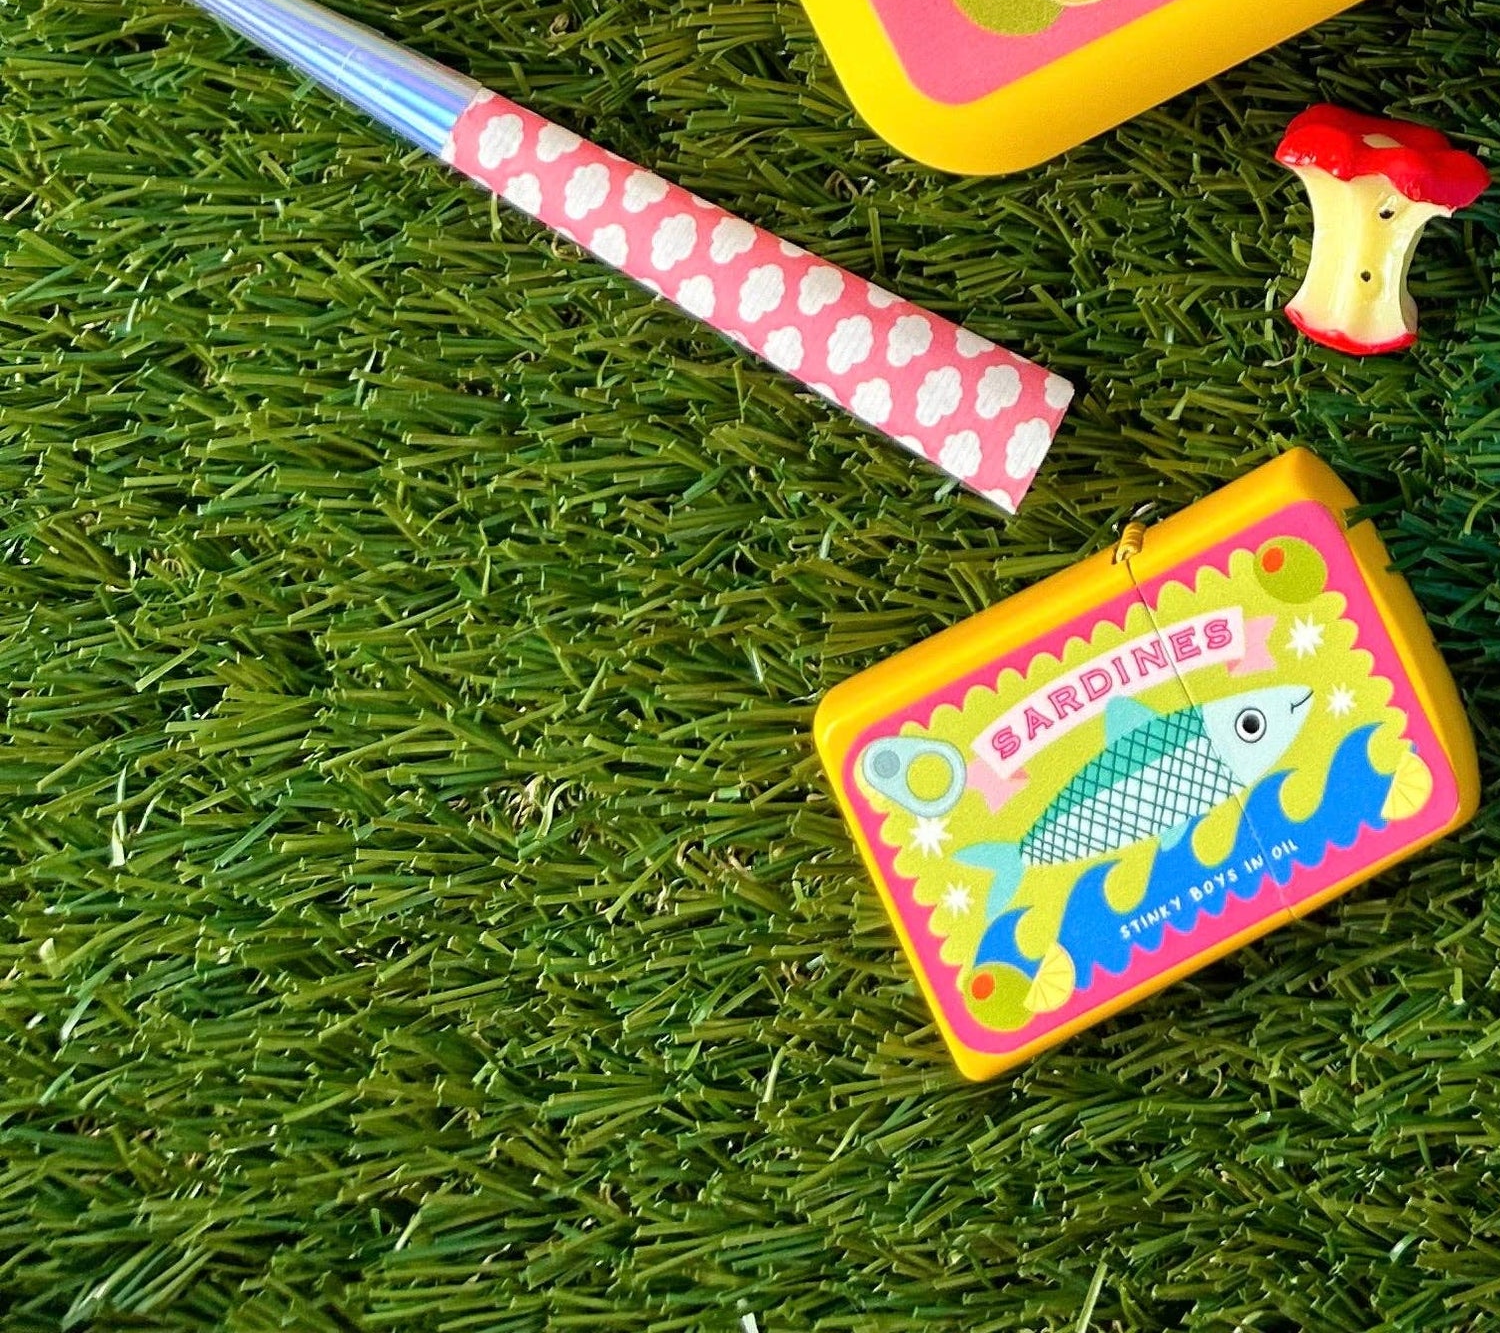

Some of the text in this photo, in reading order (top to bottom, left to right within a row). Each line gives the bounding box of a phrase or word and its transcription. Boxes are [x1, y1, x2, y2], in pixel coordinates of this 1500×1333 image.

[991, 619, 1232, 759] SARDINES
[1119, 838, 1298, 940] STINKY BOYS IN OIL
